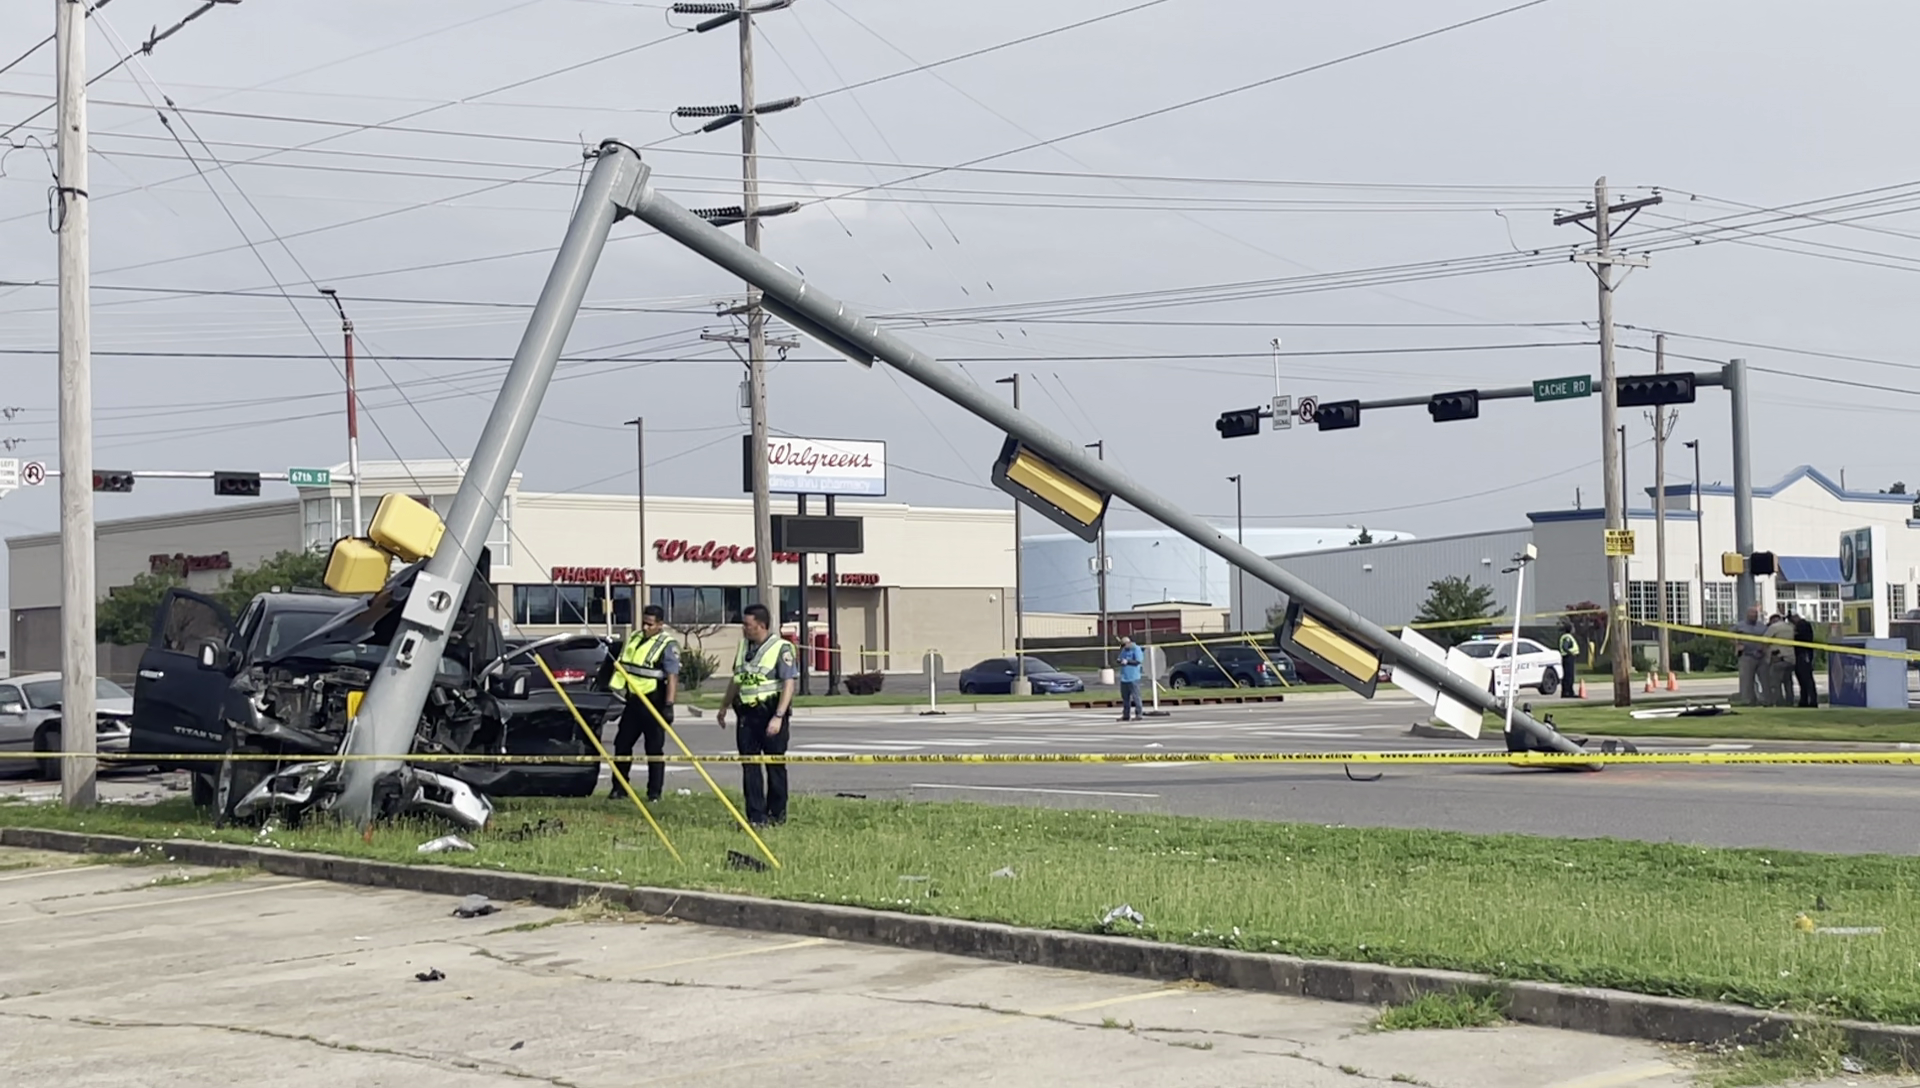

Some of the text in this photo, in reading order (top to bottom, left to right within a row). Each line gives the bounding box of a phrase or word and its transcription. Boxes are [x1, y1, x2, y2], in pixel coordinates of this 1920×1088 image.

[1538, 380, 1586, 397] CACHE RD
[767, 442, 873, 474] Walgreens
[291, 471, 327, 483] 67th ST
[652, 538, 800, 570] Walgrens
[552, 566, 645, 584] PHARMACY
[173, 726, 207, 738] TITAN
